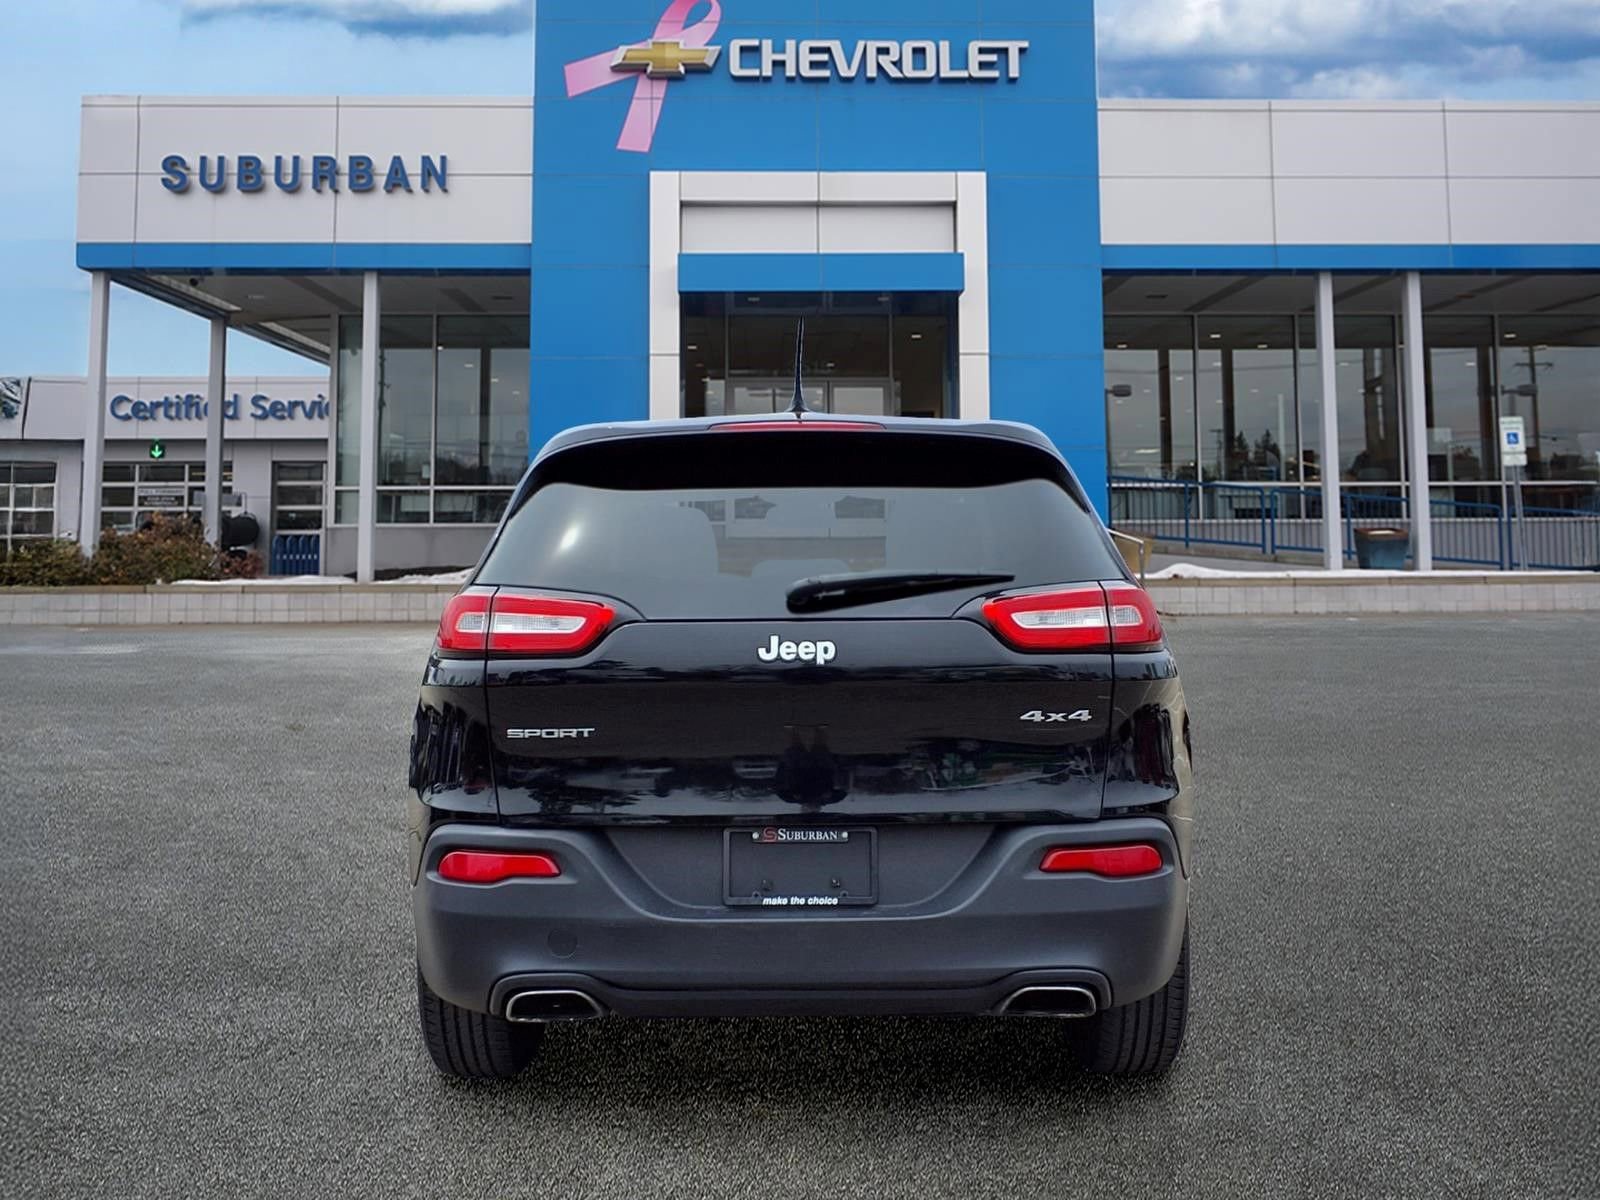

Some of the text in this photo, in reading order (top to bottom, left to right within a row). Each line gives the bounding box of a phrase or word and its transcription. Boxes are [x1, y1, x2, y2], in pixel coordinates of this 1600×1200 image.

[729, 39, 1029, 78] CHEVROLET
[161, 155, 449, 193] SUBURBAN
[757, 635, 836, 665] Jeep
[1020, 709, 1092, 722] 4x4
[506, 728, 595, 738] SPORT
[762, 896, 839, 905] make the choice
